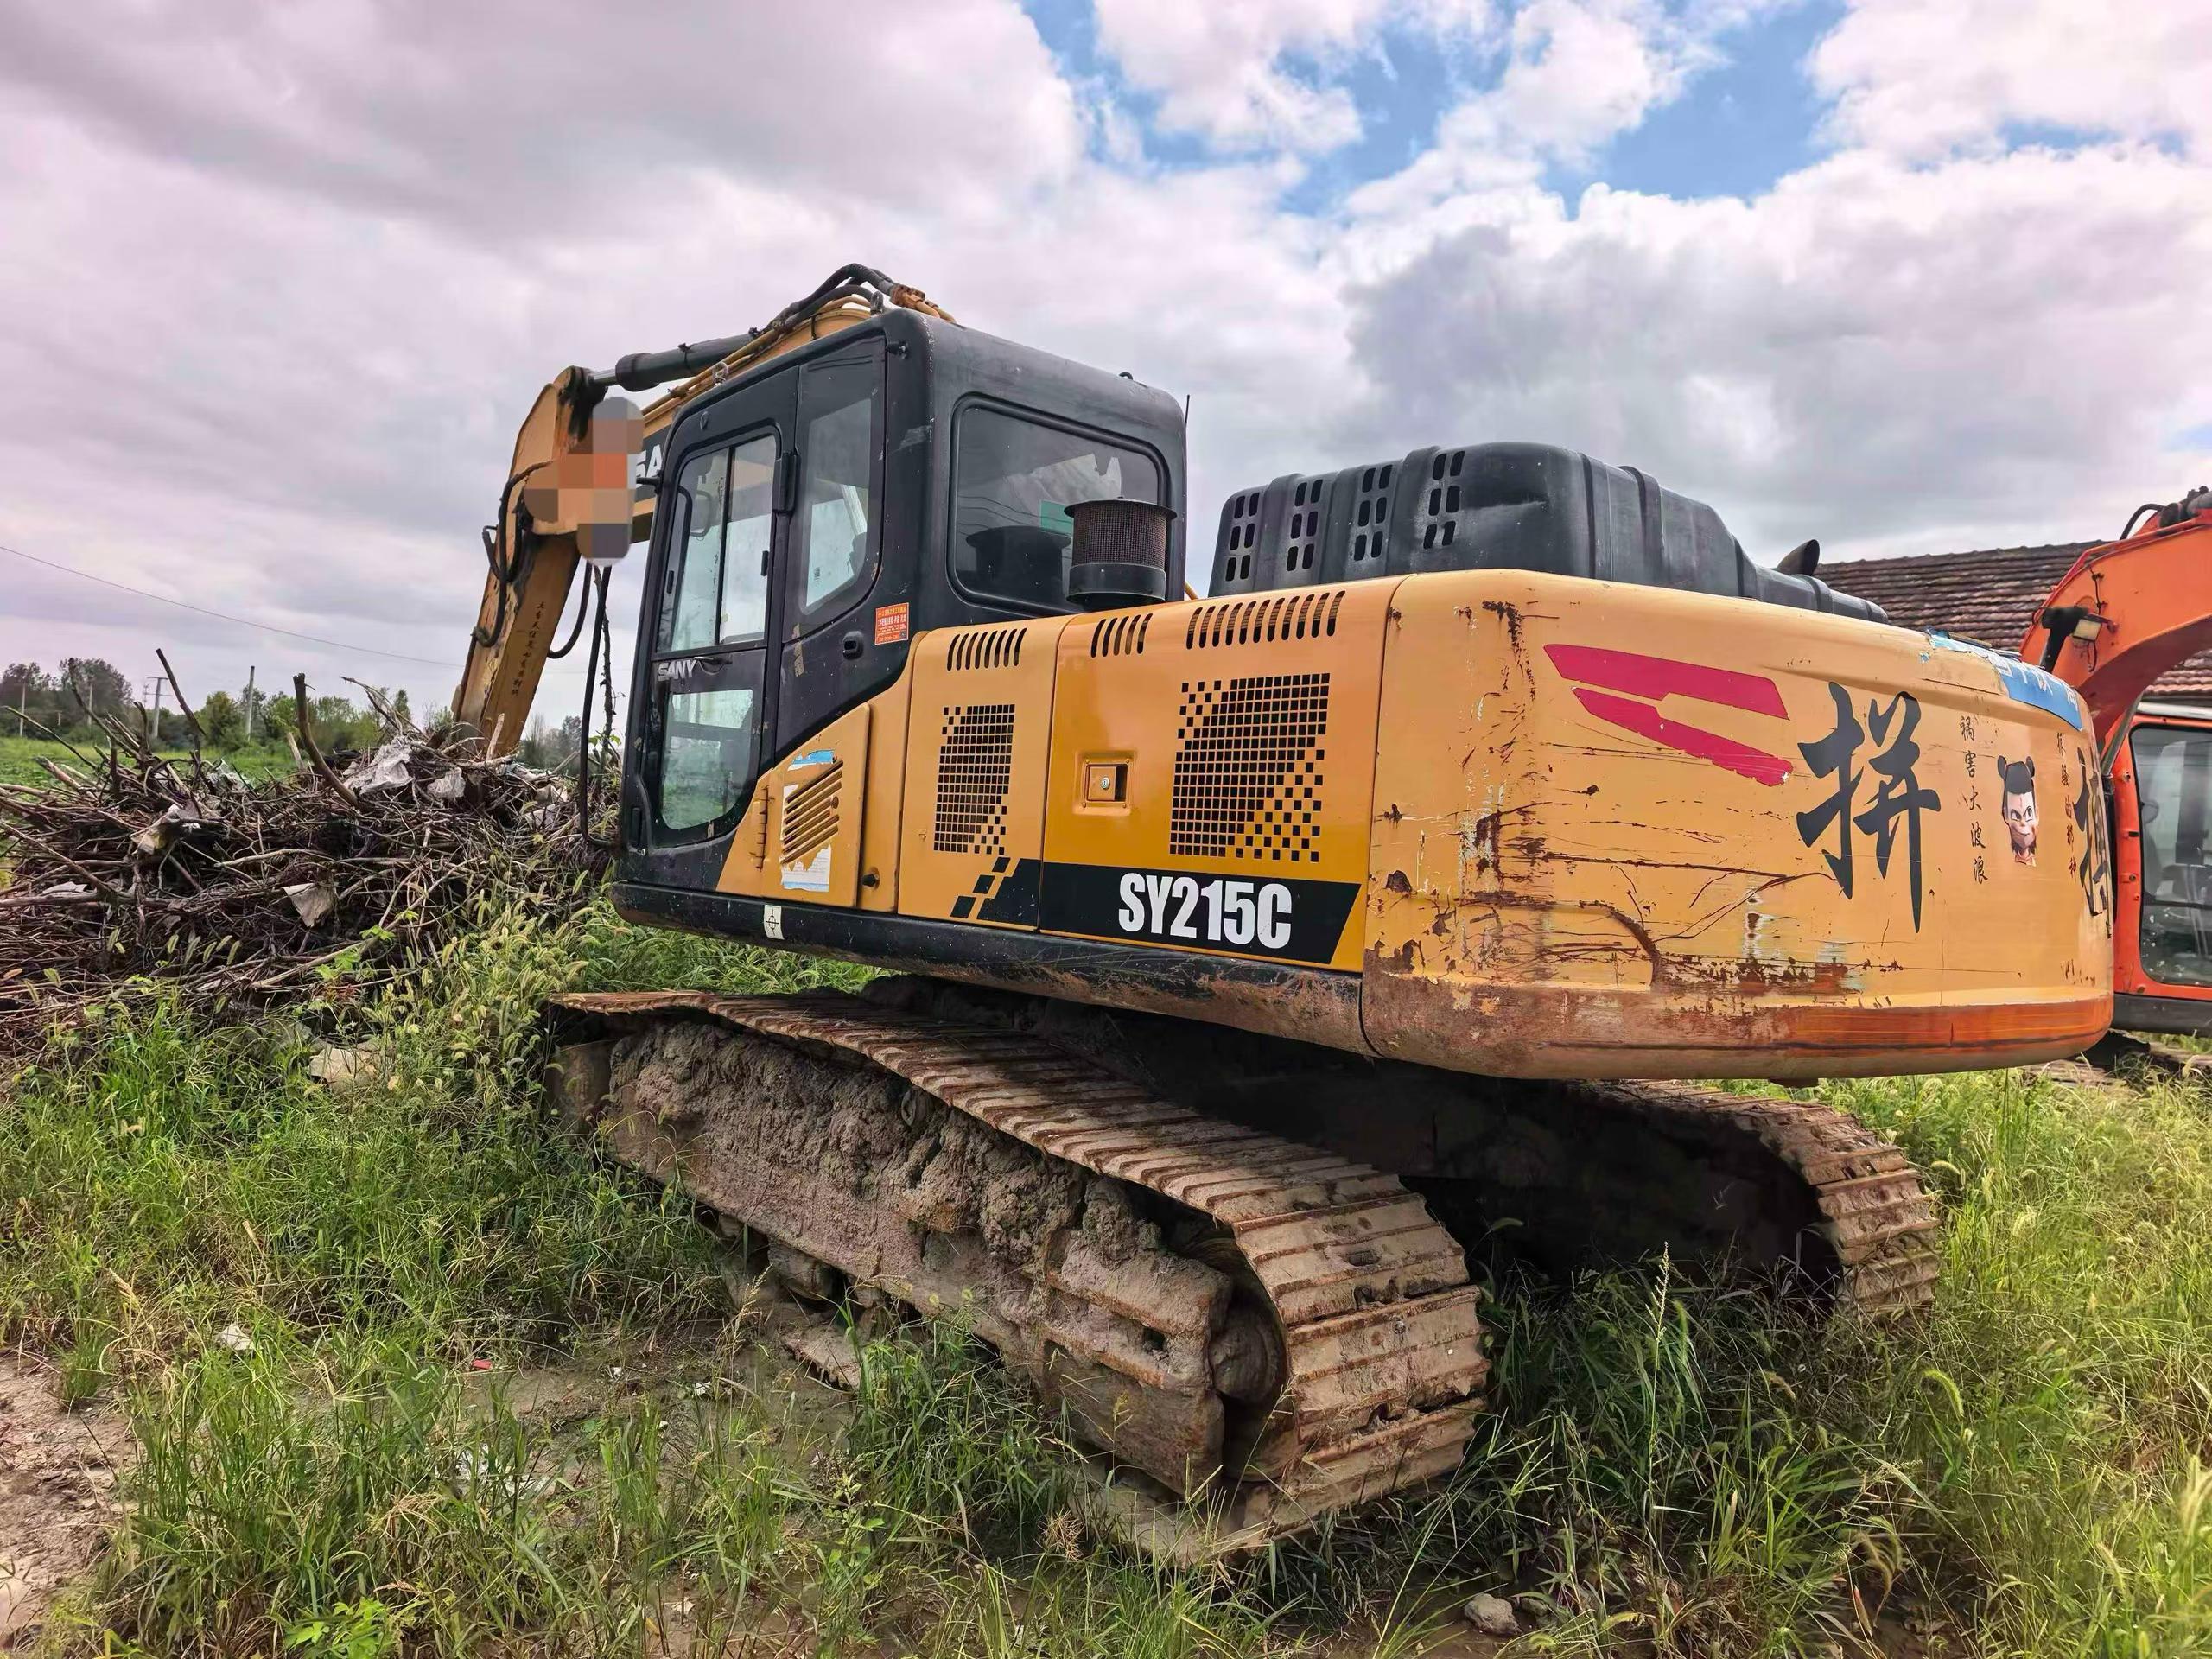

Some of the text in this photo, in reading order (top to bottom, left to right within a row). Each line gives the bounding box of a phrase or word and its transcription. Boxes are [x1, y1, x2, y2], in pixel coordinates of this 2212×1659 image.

[658, 659, 696, 681] SANY
[1796, 681, 1942, 934] 拼
[1118, 872, 1293, 950] SY215C
